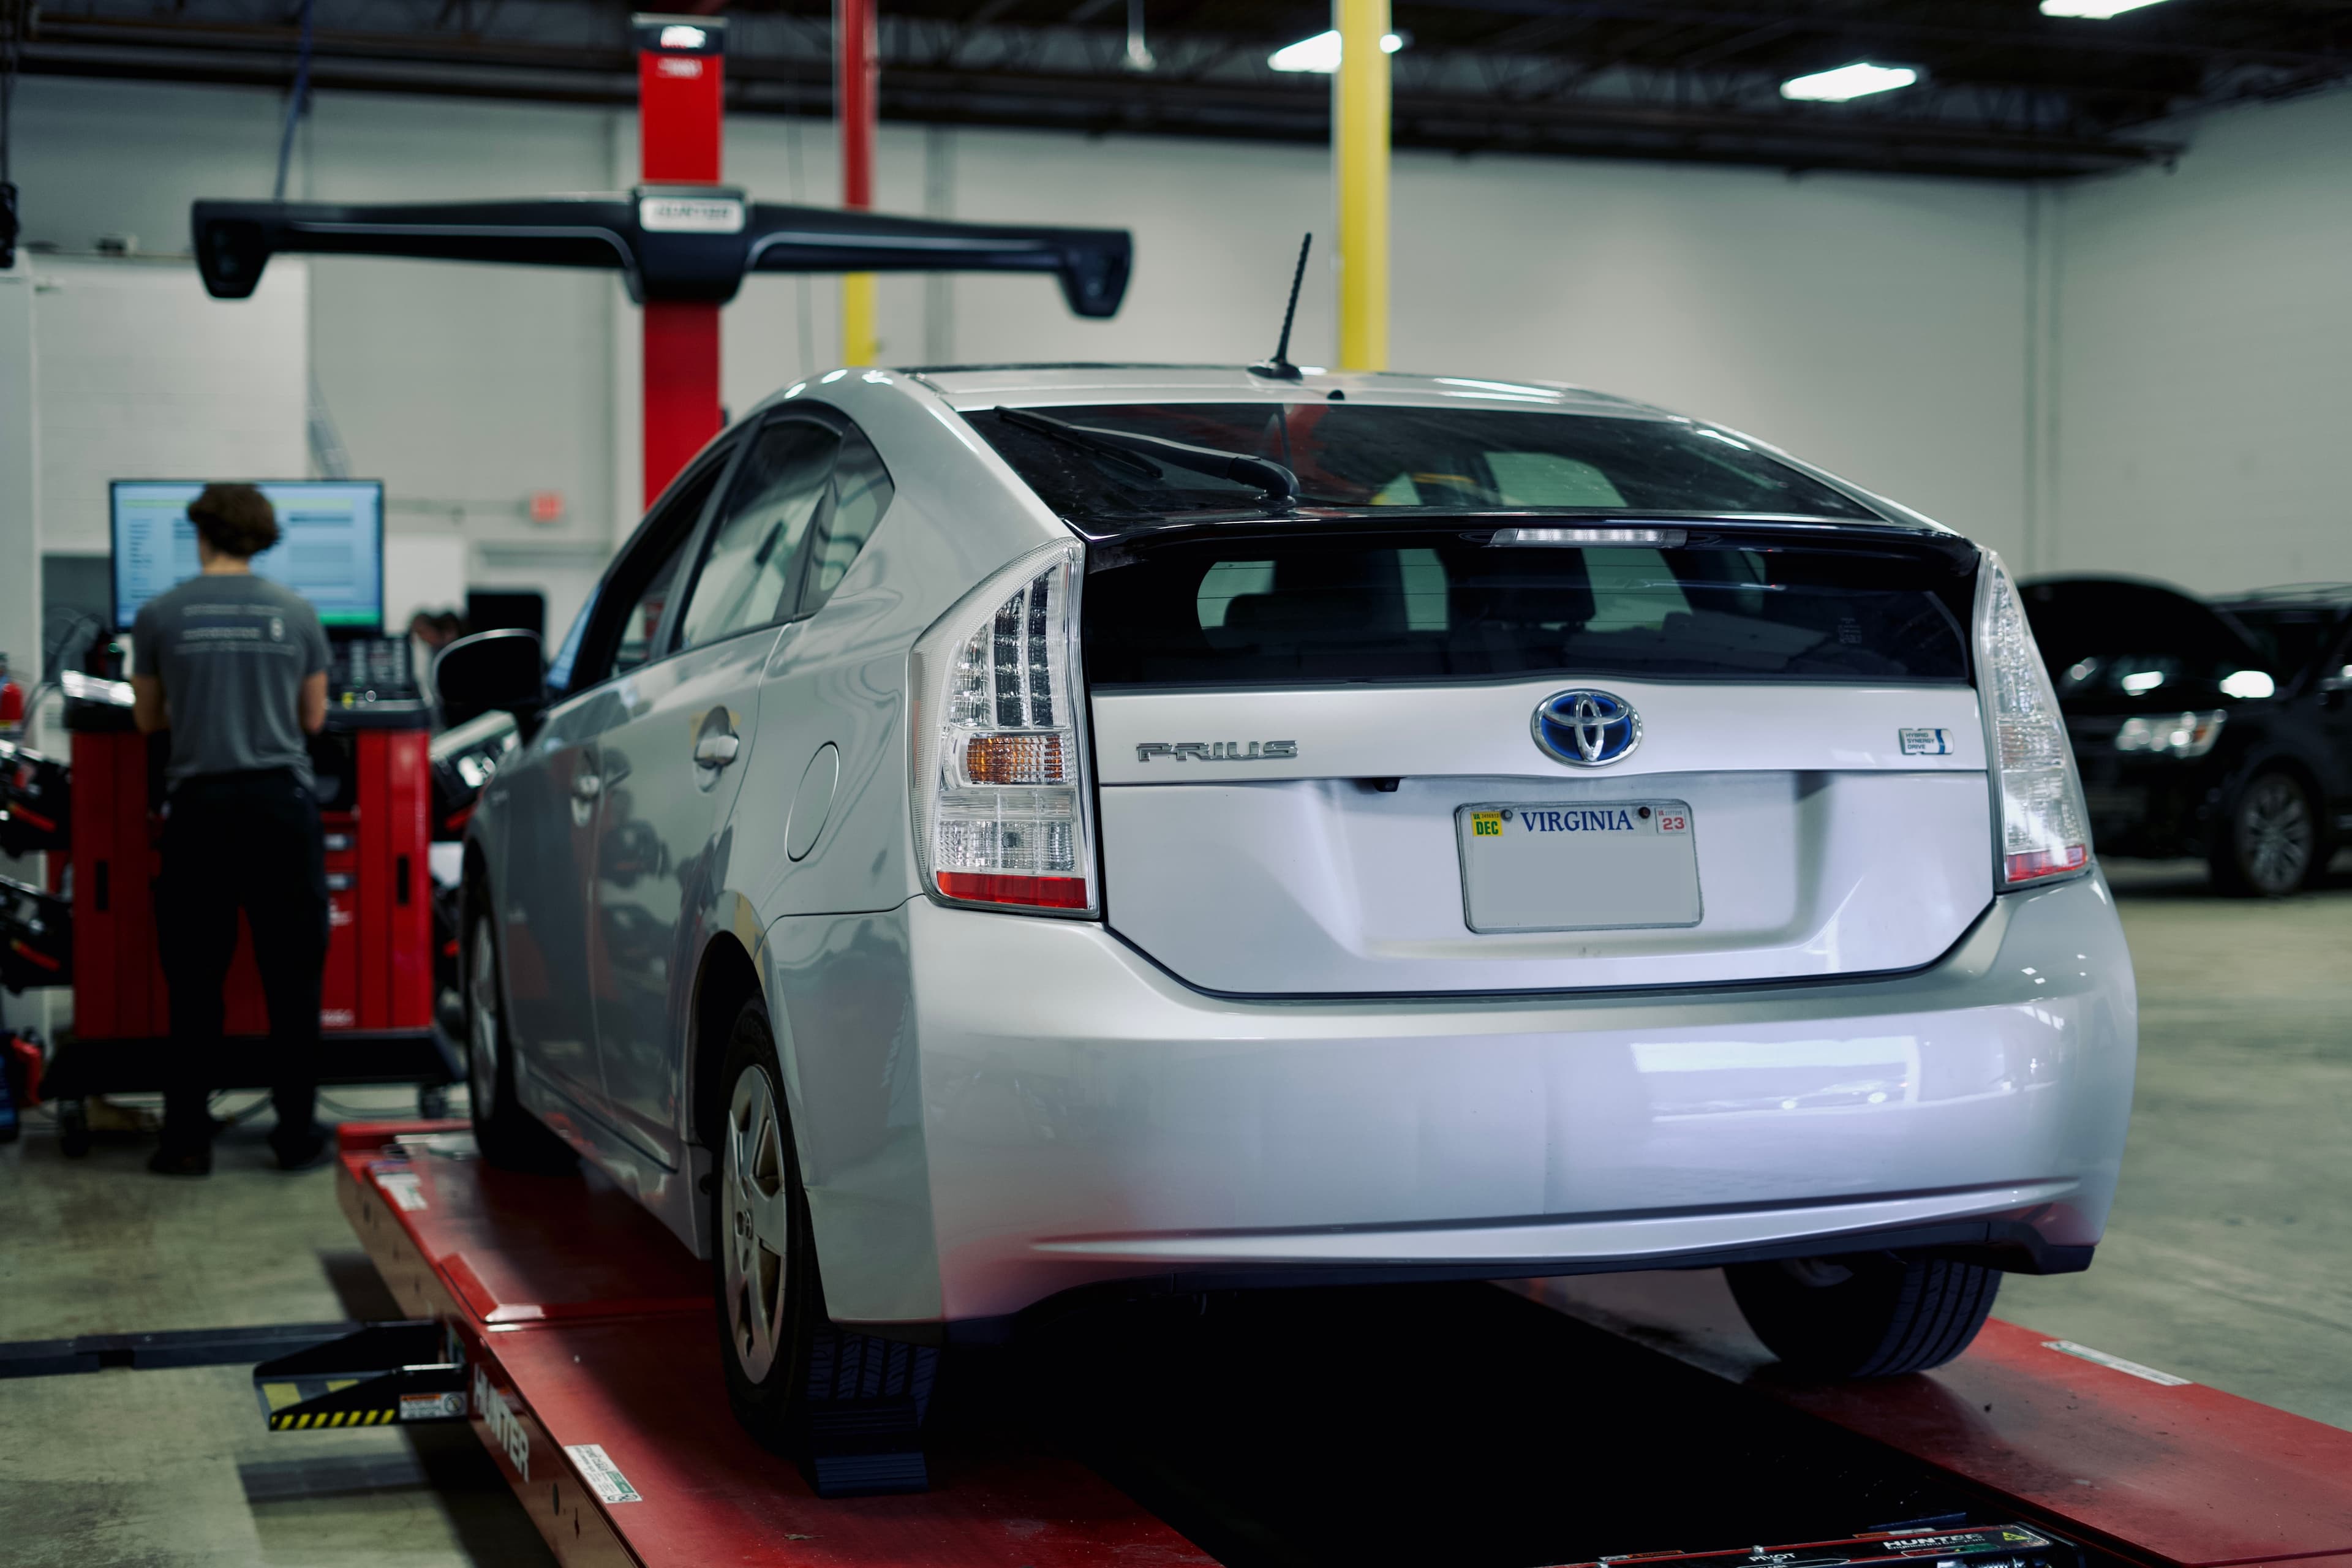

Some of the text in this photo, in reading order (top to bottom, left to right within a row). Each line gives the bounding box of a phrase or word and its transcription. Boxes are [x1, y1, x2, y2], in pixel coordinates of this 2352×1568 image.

[1136, 740, 1299, 762] PRIUS
[1476, 820, 1499, 835] DEC
[1520, 810, 1634, 832] VIRGINIA
[1662, 816, 1685, 830] 23
[473, 1362, 529, 1484] HUNTER
[1883, 1534, 1983, 1548] HUNTER
[1748, 1553, 1795, 1562] PIVOT
